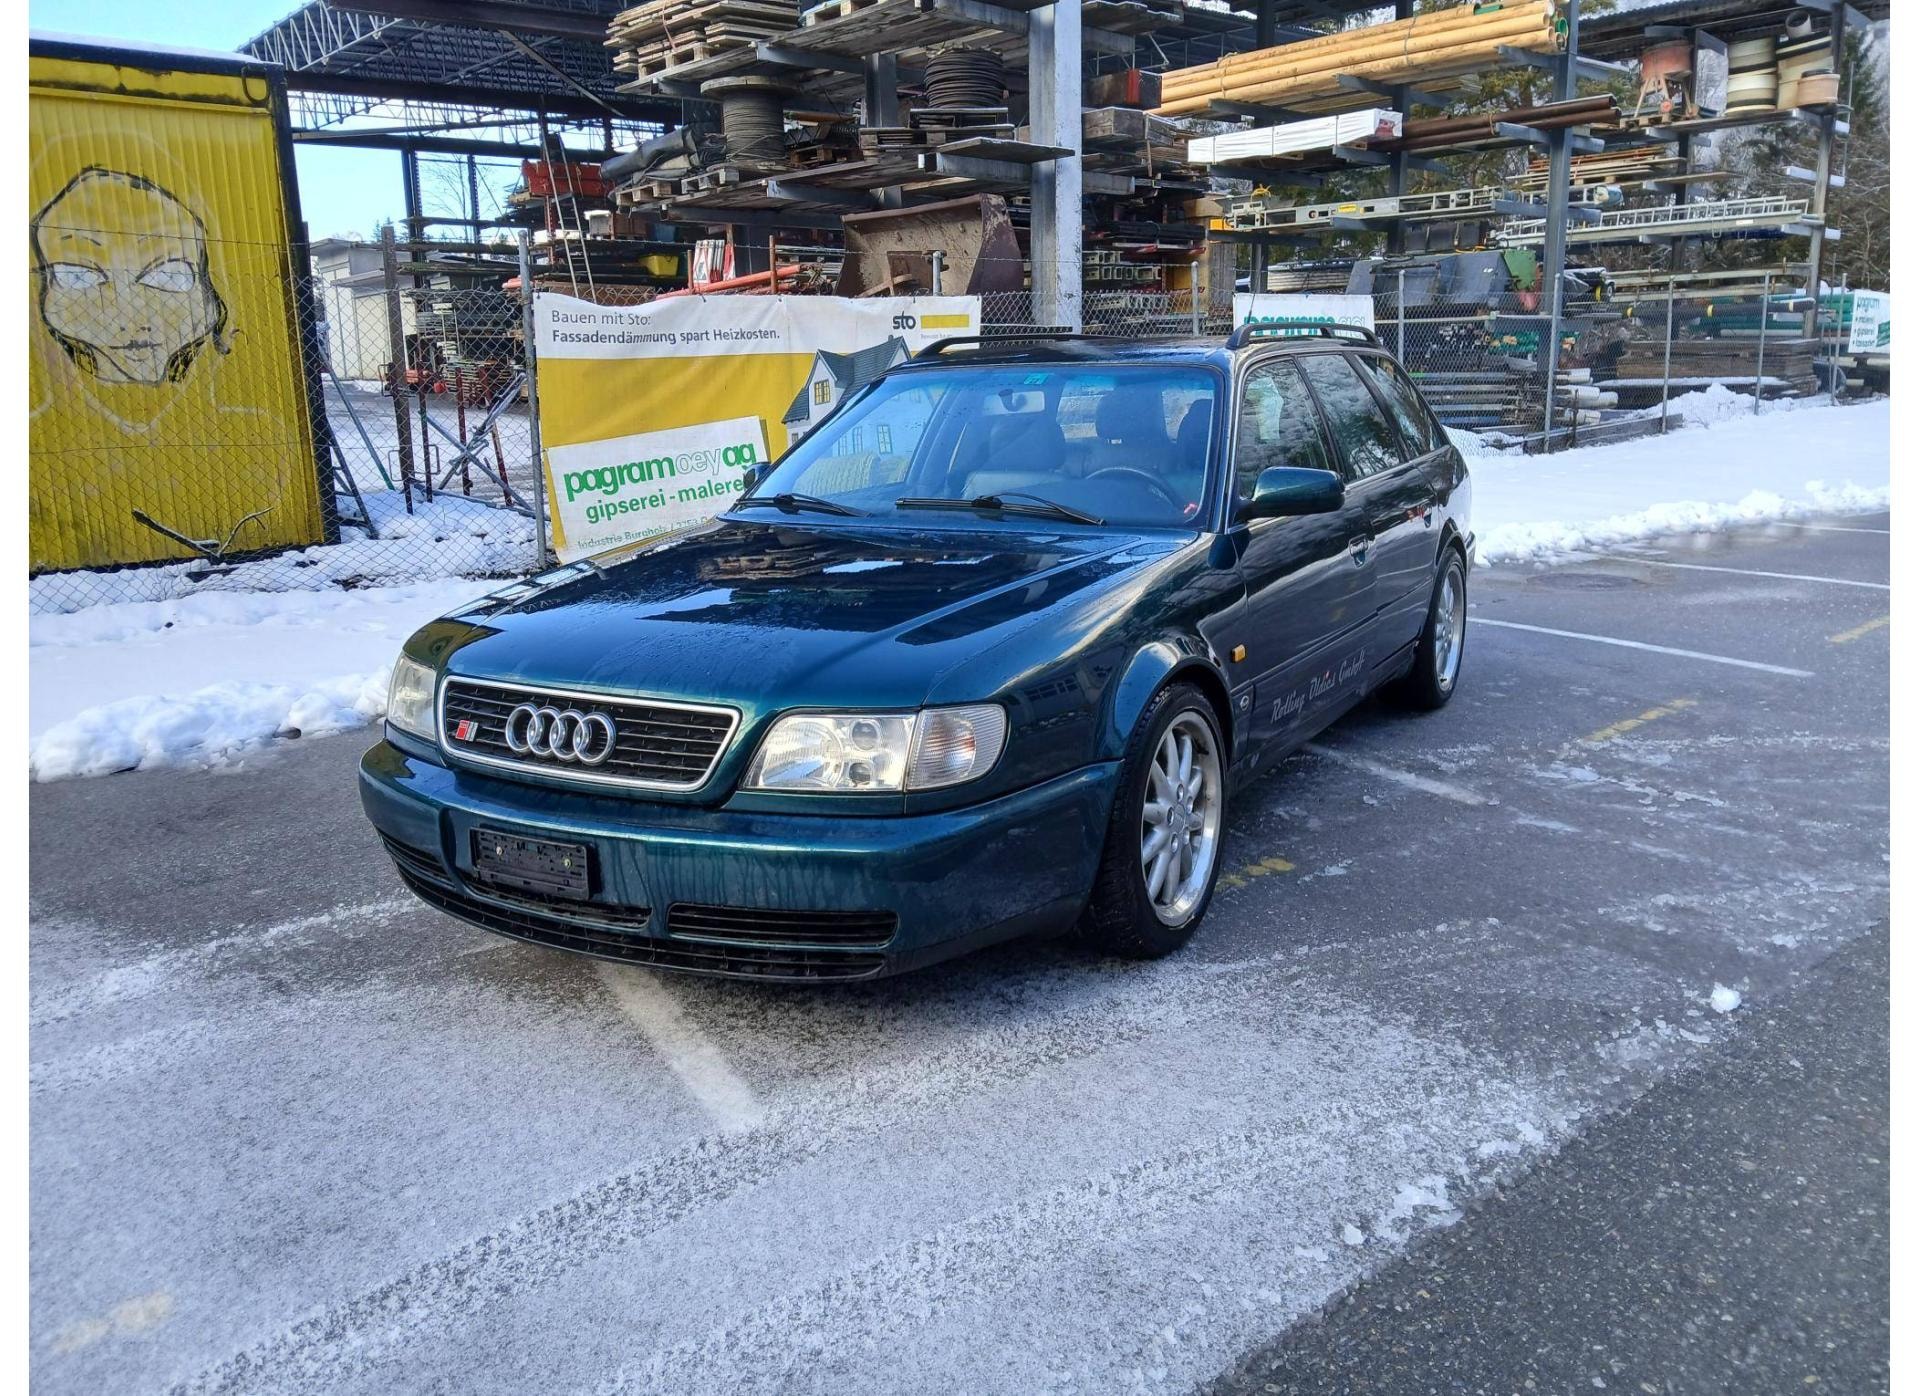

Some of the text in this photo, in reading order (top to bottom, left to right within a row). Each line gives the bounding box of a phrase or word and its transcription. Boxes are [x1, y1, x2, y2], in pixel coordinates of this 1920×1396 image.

[551, 310, 651, 325] Bauen mit Sto:
[892, 310, 917, 330] sto
[552, 327, 780, 345] Fassadendämmung spart Heizkosten.
[586, 489, 666, 524] gipserei
[678, 479, 744, 503] malere
[577, 534, 622, 550] Industrie
[1271, 690, 1305, 724] Rolling
